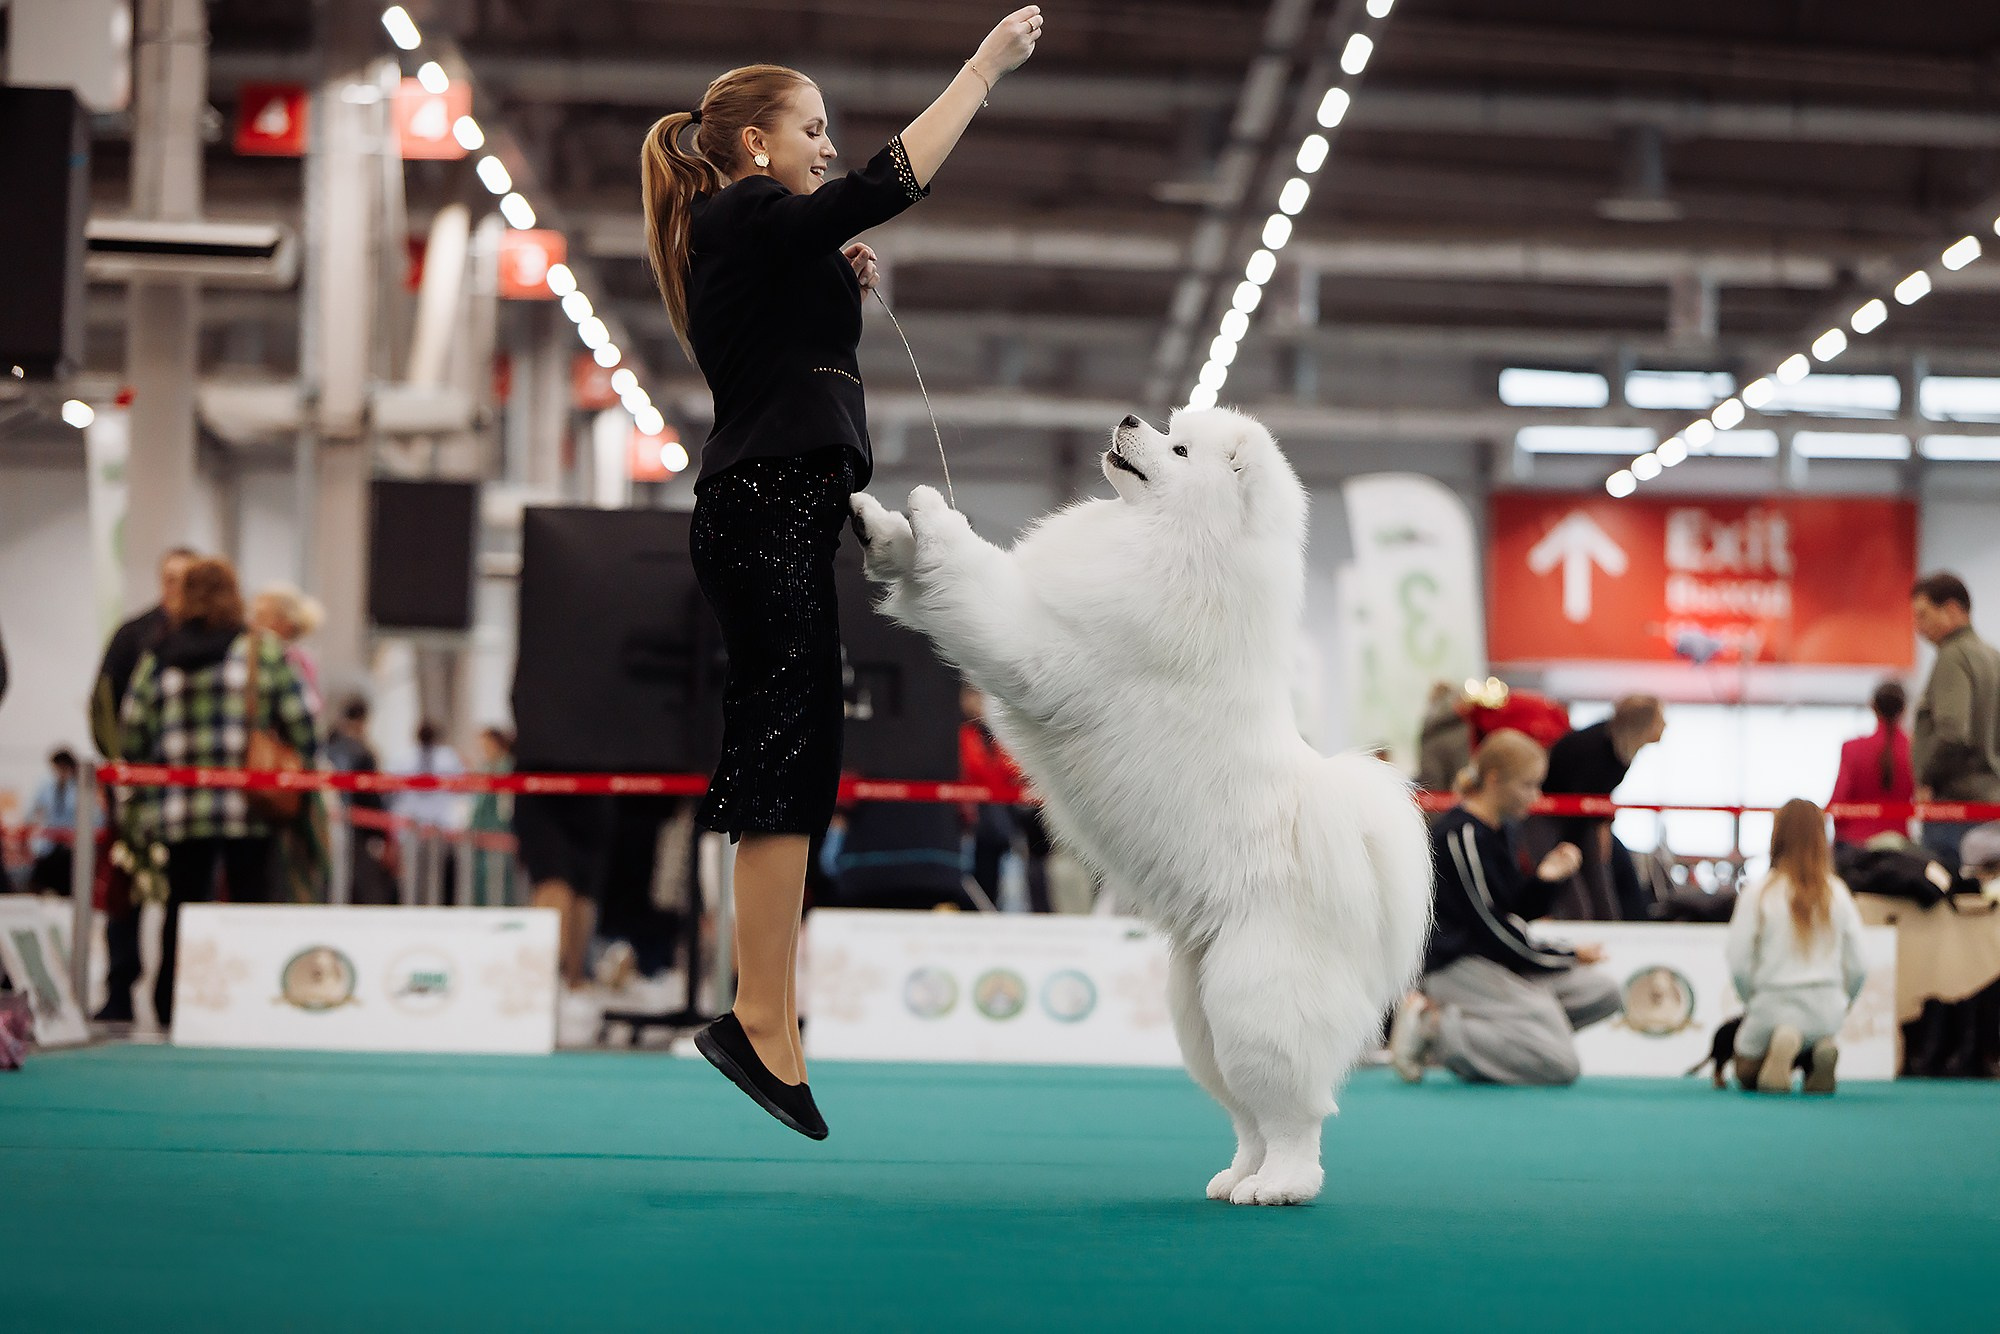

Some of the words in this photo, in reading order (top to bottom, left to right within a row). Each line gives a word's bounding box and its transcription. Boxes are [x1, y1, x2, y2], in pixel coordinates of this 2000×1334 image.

[253, 97, 291, 138] 4
[410, 98, 449, 141] 4
[1665, 508, 1791, 573] Exit
